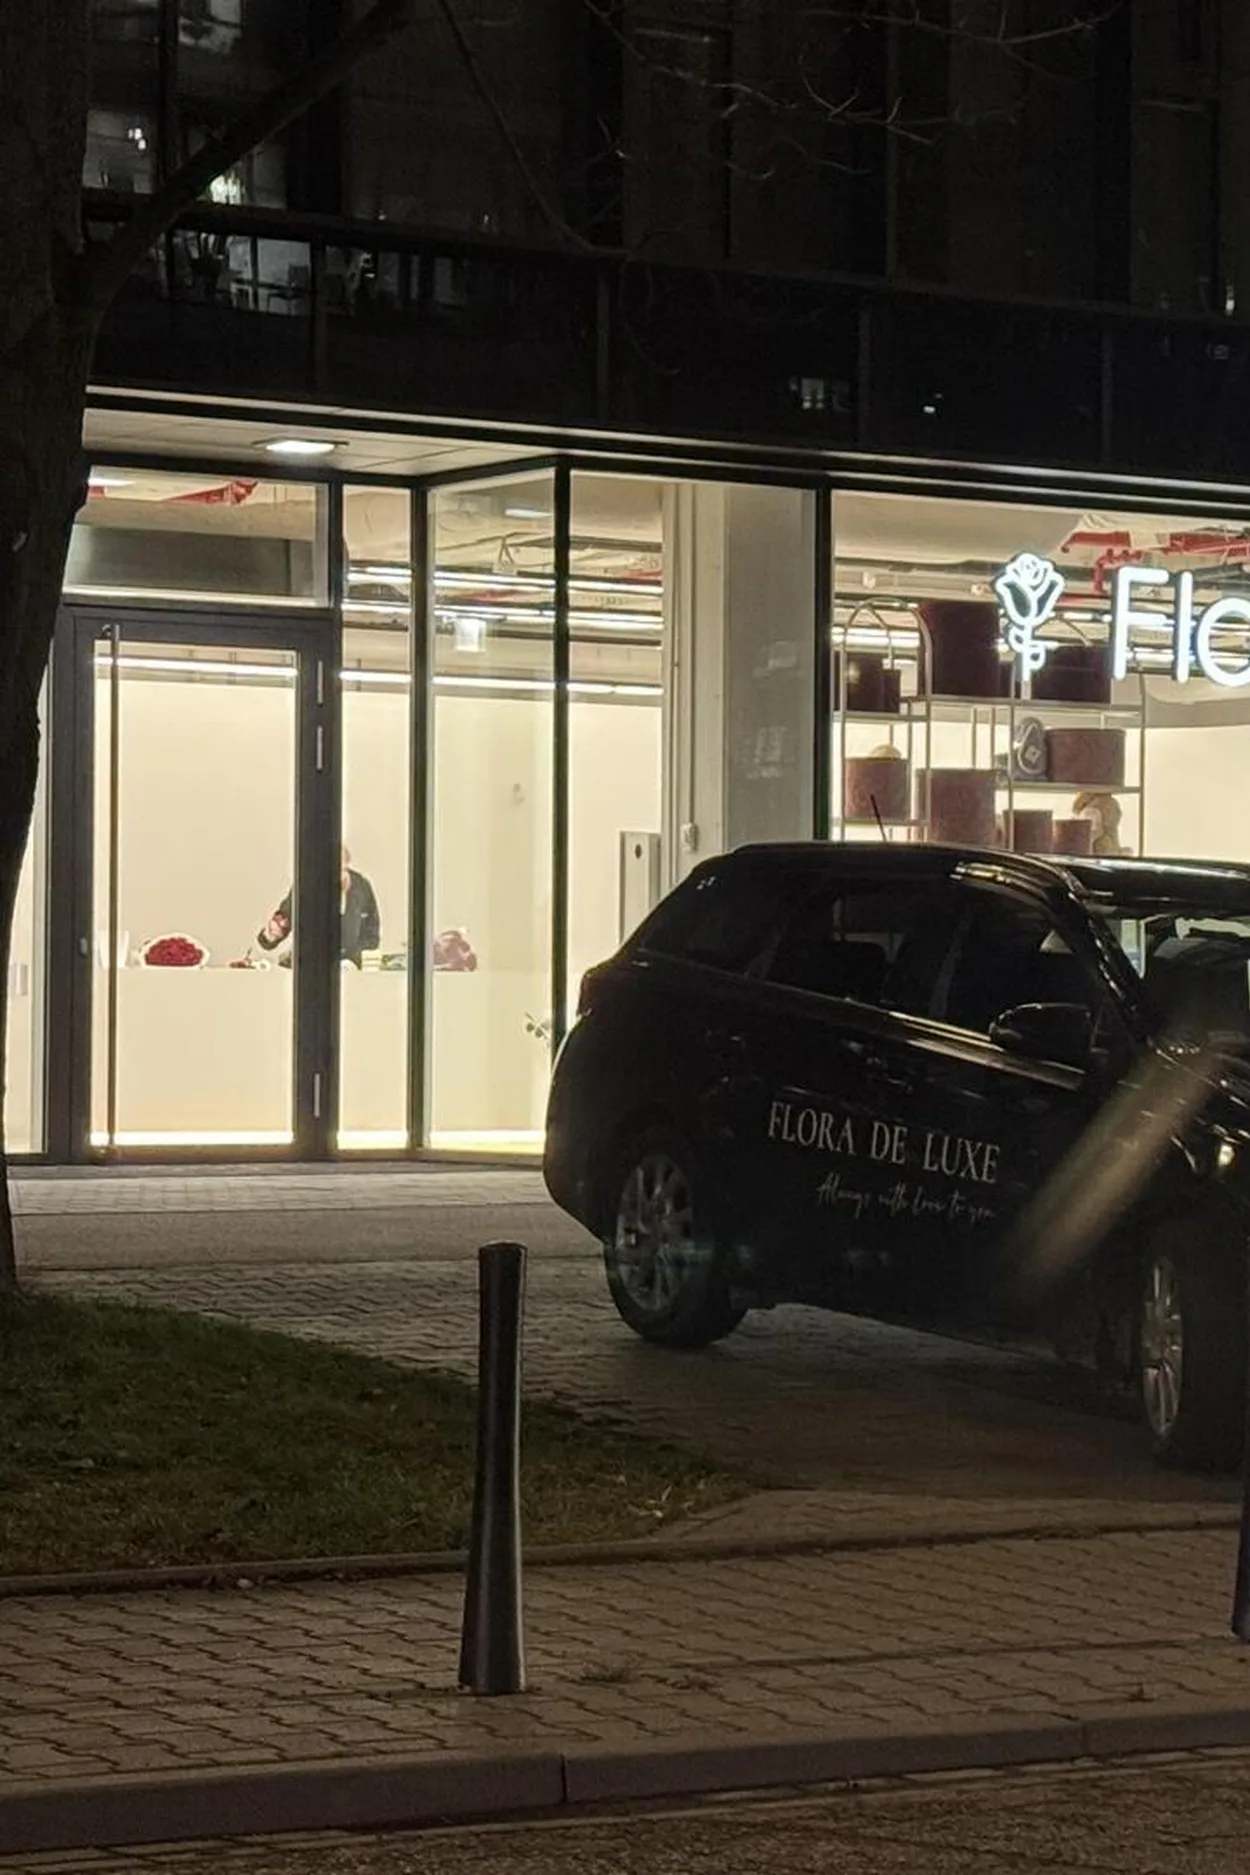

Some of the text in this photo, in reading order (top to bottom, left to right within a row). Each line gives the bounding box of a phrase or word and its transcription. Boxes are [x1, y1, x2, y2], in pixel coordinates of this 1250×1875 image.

[768, 1101, 1001, 1184] FLORA DE LUXE
